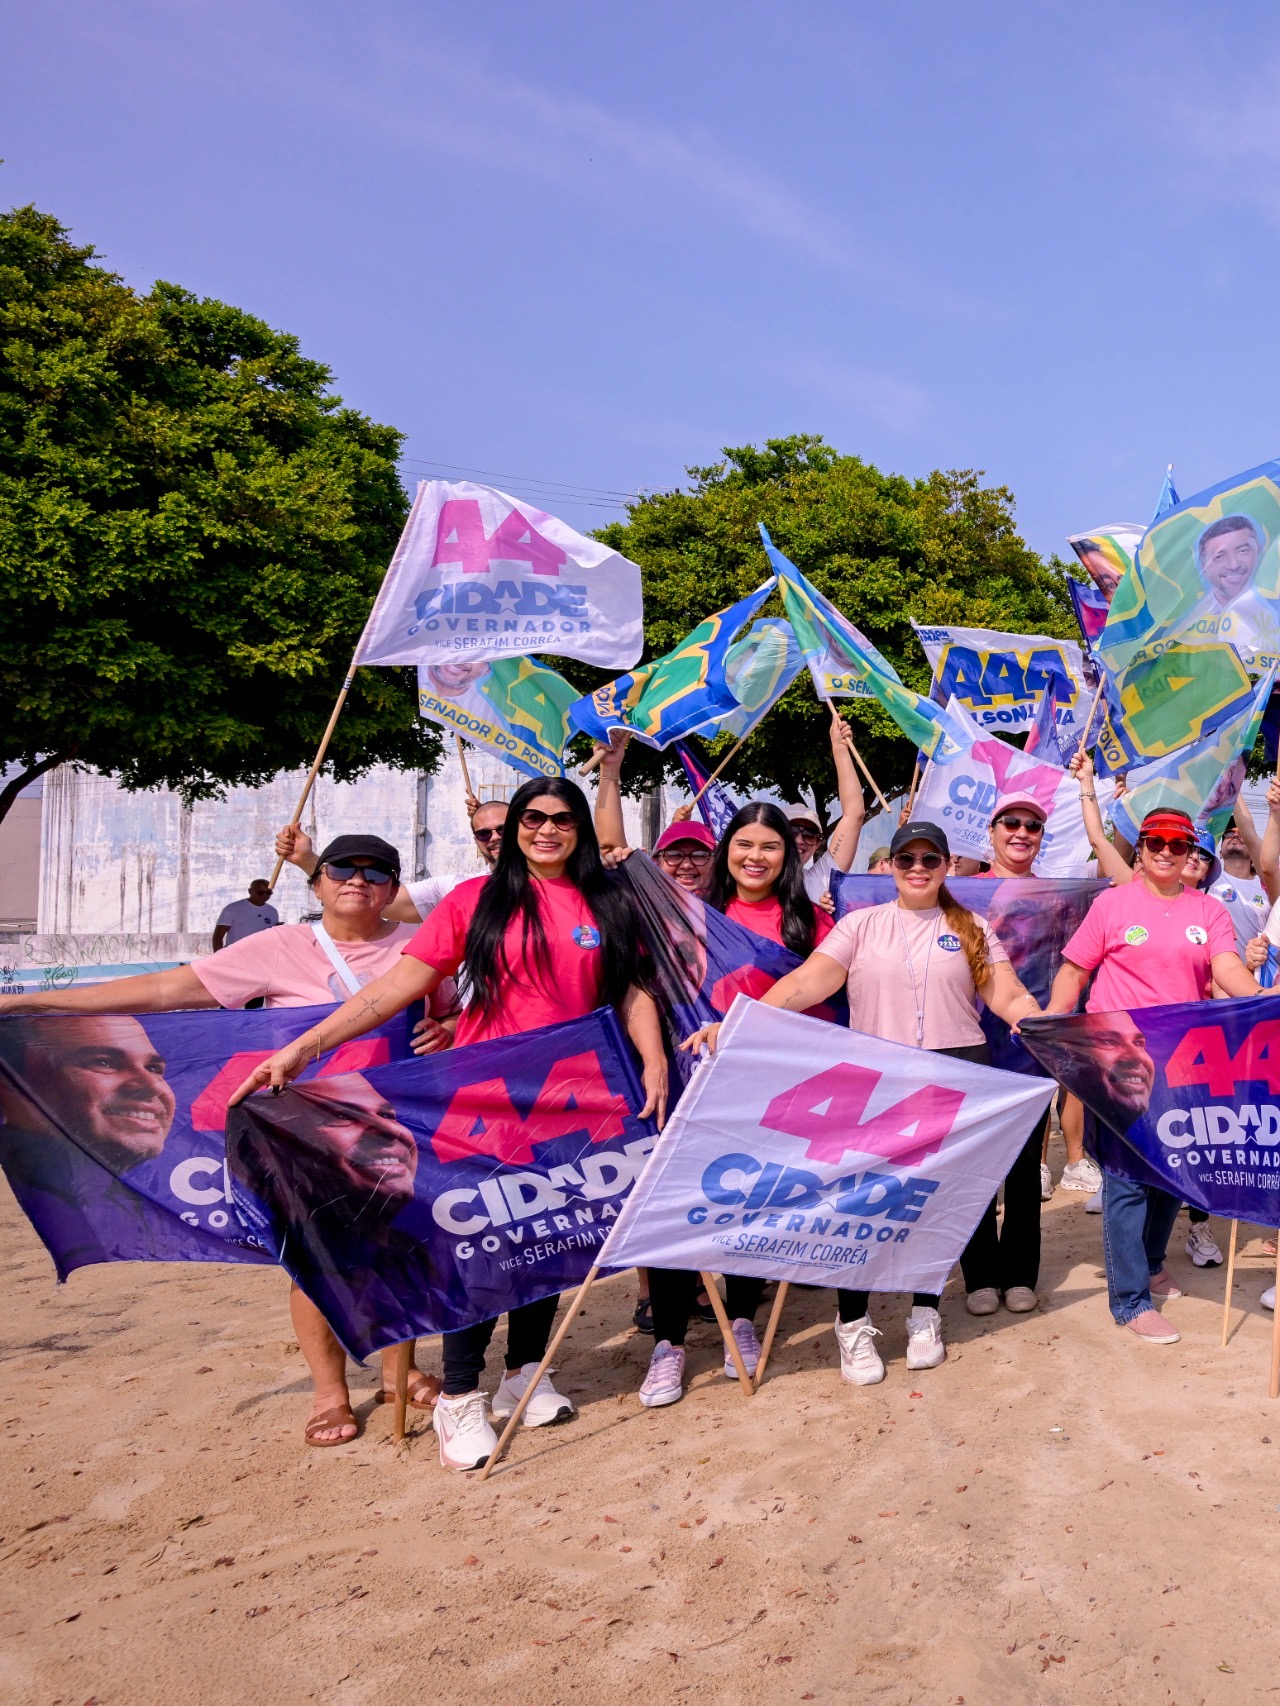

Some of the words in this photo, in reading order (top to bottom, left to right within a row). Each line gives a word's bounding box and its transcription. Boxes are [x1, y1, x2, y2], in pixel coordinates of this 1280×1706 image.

[431, 500, 567, 576] 44
[414, 580, 589, 620] CIDADE
[407, 618, 591, 636] GOVERNADOR
[454, 637, 509, 649] SERAFIM
[419, 694, 491, 738] SENADOR
[494, 733, 518, 751] DO
[521, 746, 557, 776] POVO
[431, 1050, 633, 1165] 44
[758, 1061, 966, 1167] 44
[701, 1152, 941, 1223] CIDADE
[1214, 1170, 1255, 1188] SERAFIM
[687, 1206, 911, 1243] GOVERNADOR
[499, 1255, 522, 1271] VICE
[523, 1231, 596, 1265] SERAFIM
[711, 1235, 732, 1246] VICE
[734, 1233, 809, 1259] SERAFIM
[810, 1243, 869, 1266] CORRÊA
